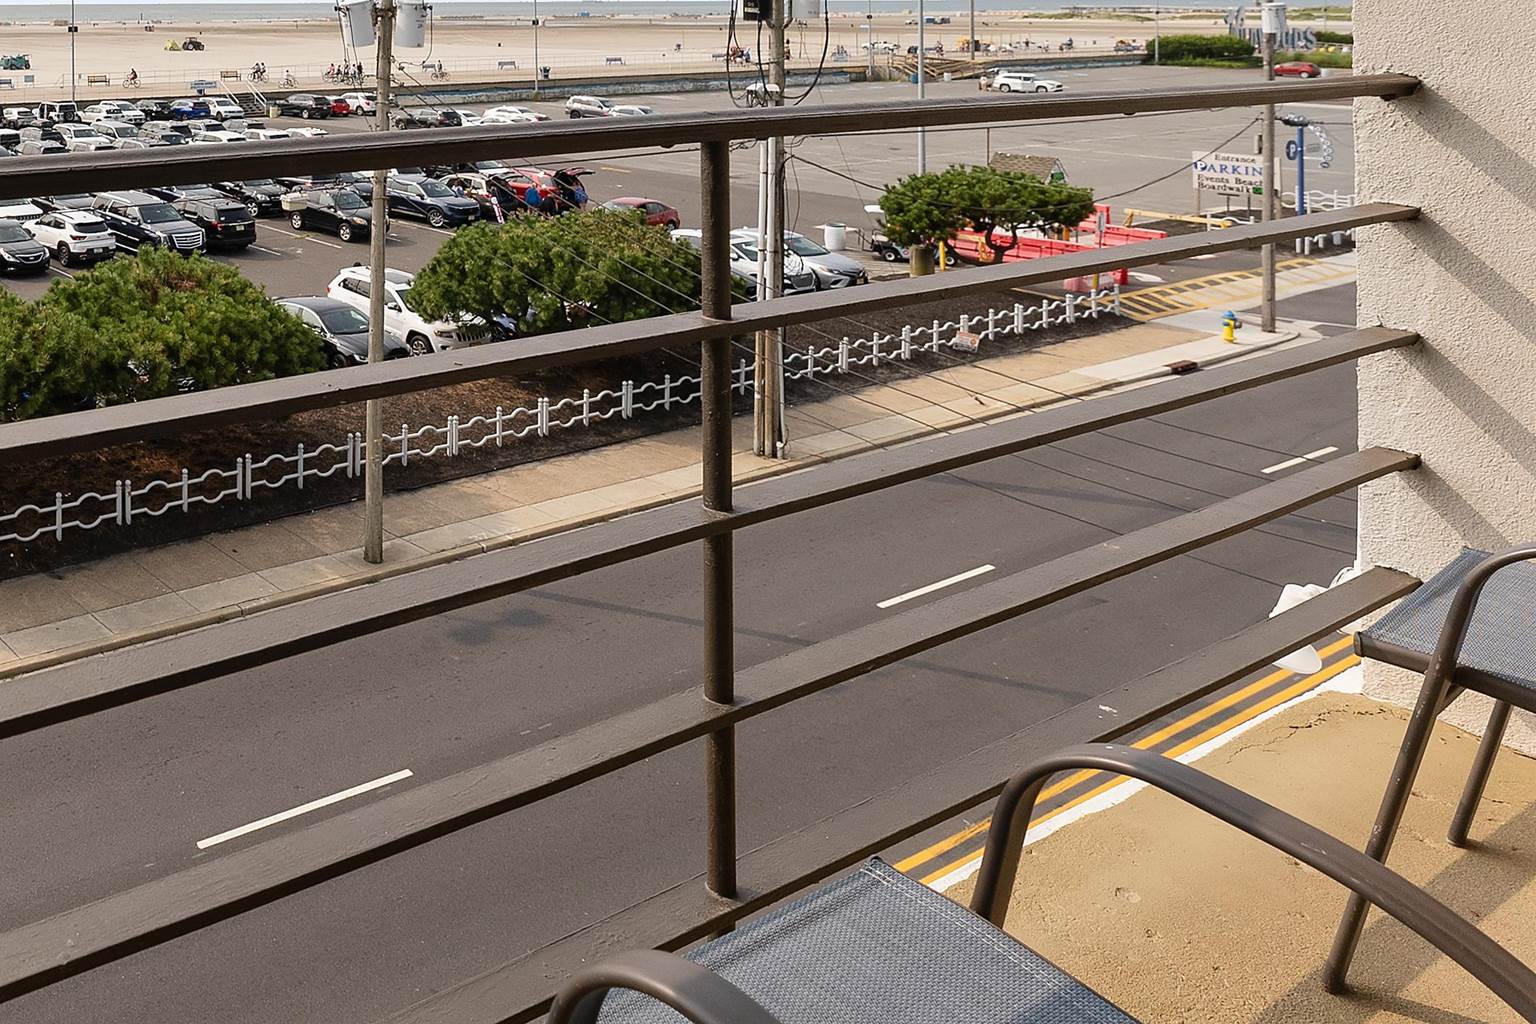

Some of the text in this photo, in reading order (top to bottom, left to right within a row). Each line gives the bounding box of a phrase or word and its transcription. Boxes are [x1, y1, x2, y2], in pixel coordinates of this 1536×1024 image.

[1289, 144, 1296, 157] P
[1214, 154, 1256, 163] Entrance
[1196, 161, 1263, 175] PARKIN
[1197, 174, 1229, 183] Events
[1197, 182, 1251, 193] Boardwalk
